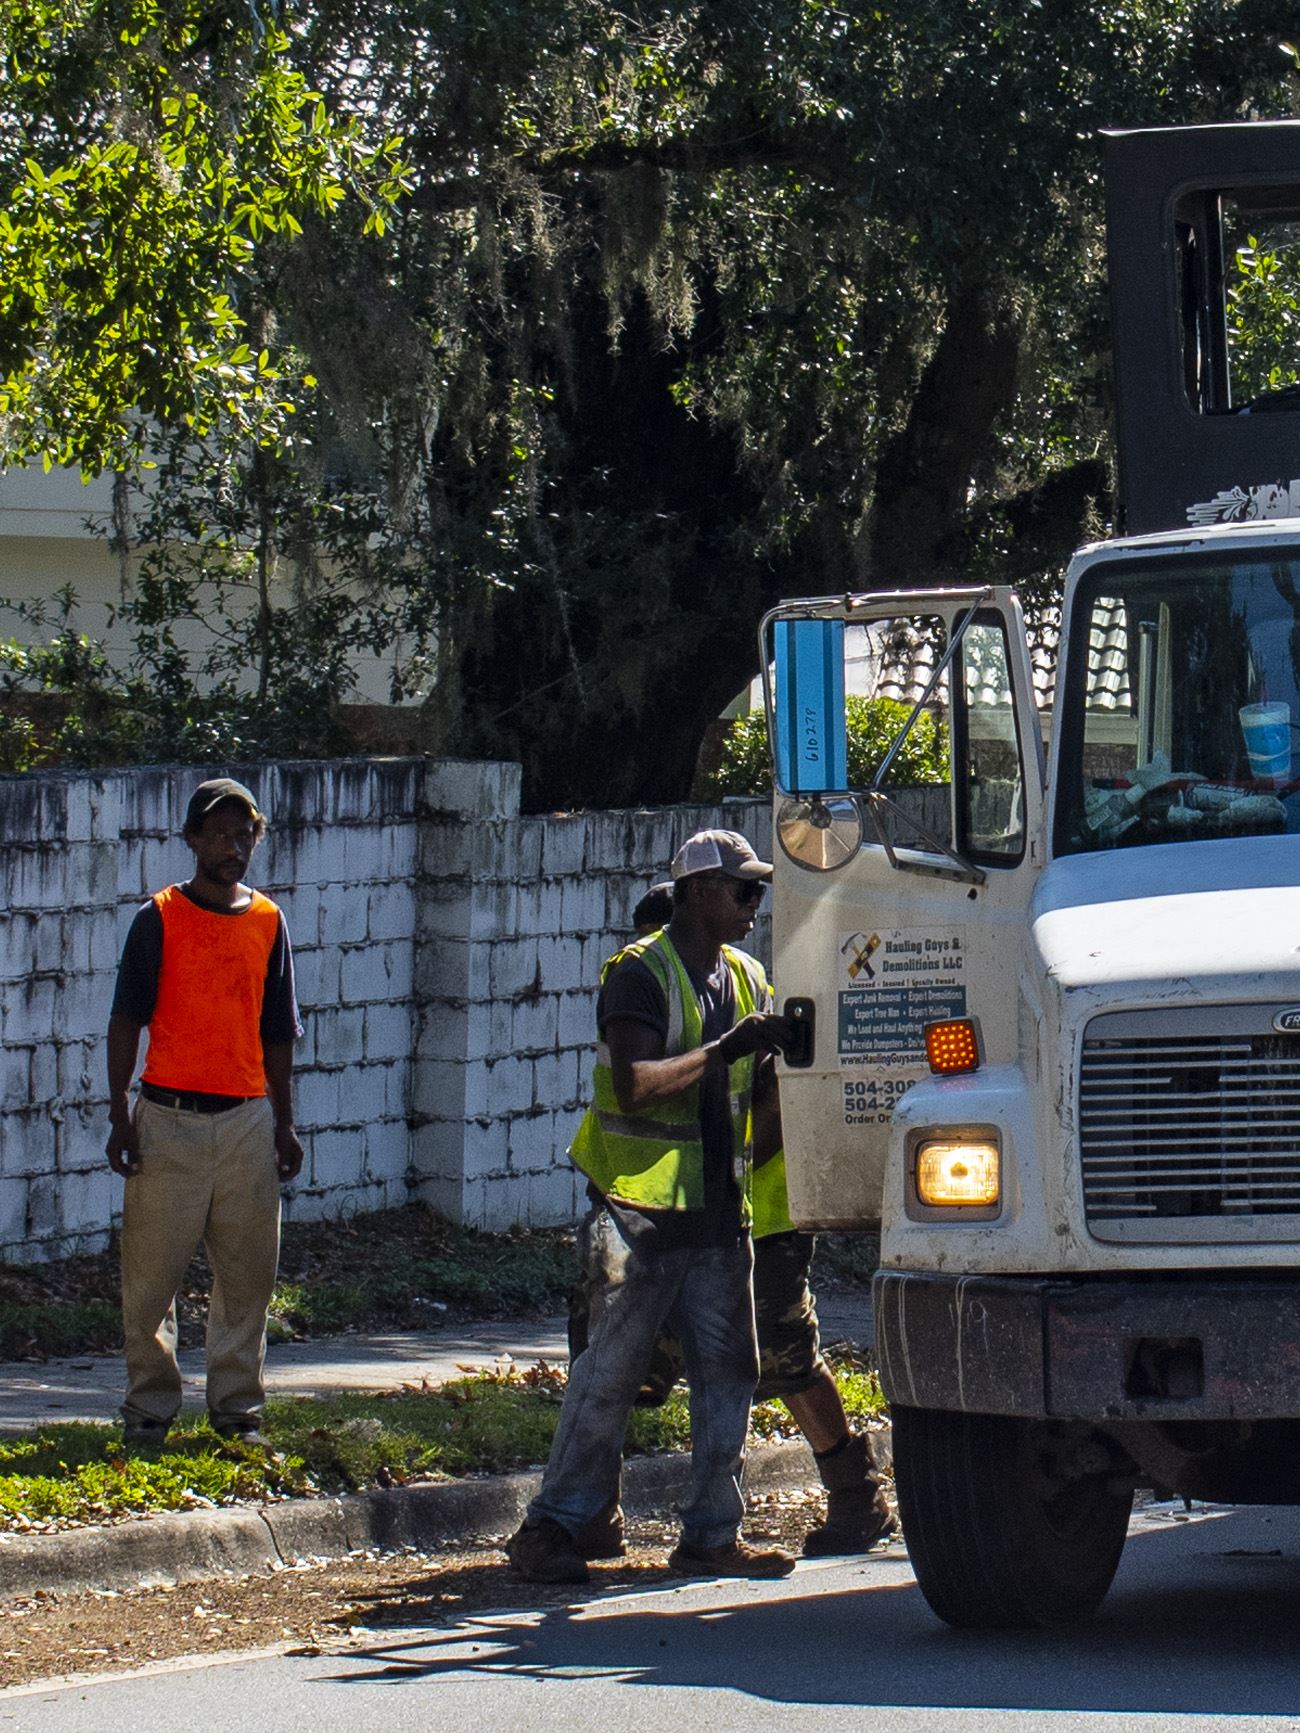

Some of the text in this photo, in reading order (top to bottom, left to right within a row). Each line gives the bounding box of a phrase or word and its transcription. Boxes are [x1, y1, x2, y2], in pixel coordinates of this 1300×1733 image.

[885, 940, 923, 954] Hauling
[925, 938, 950, 953] Guys
[882, 956, 963, 973] Demolitions LLC
[843, 993, 863, 1007] Expert
[908, 990, 927, 1003] Expert
[928, 988, 963, 1000] Demolitions
[855, 1008, 874, 1022] Expert
[908, 1005, 928, 1019] Expert
[872, 1023, 883, 1034] and
[845, 1096, 902, 1112] 504-2
[845, 1113, 876, 1125] Order
